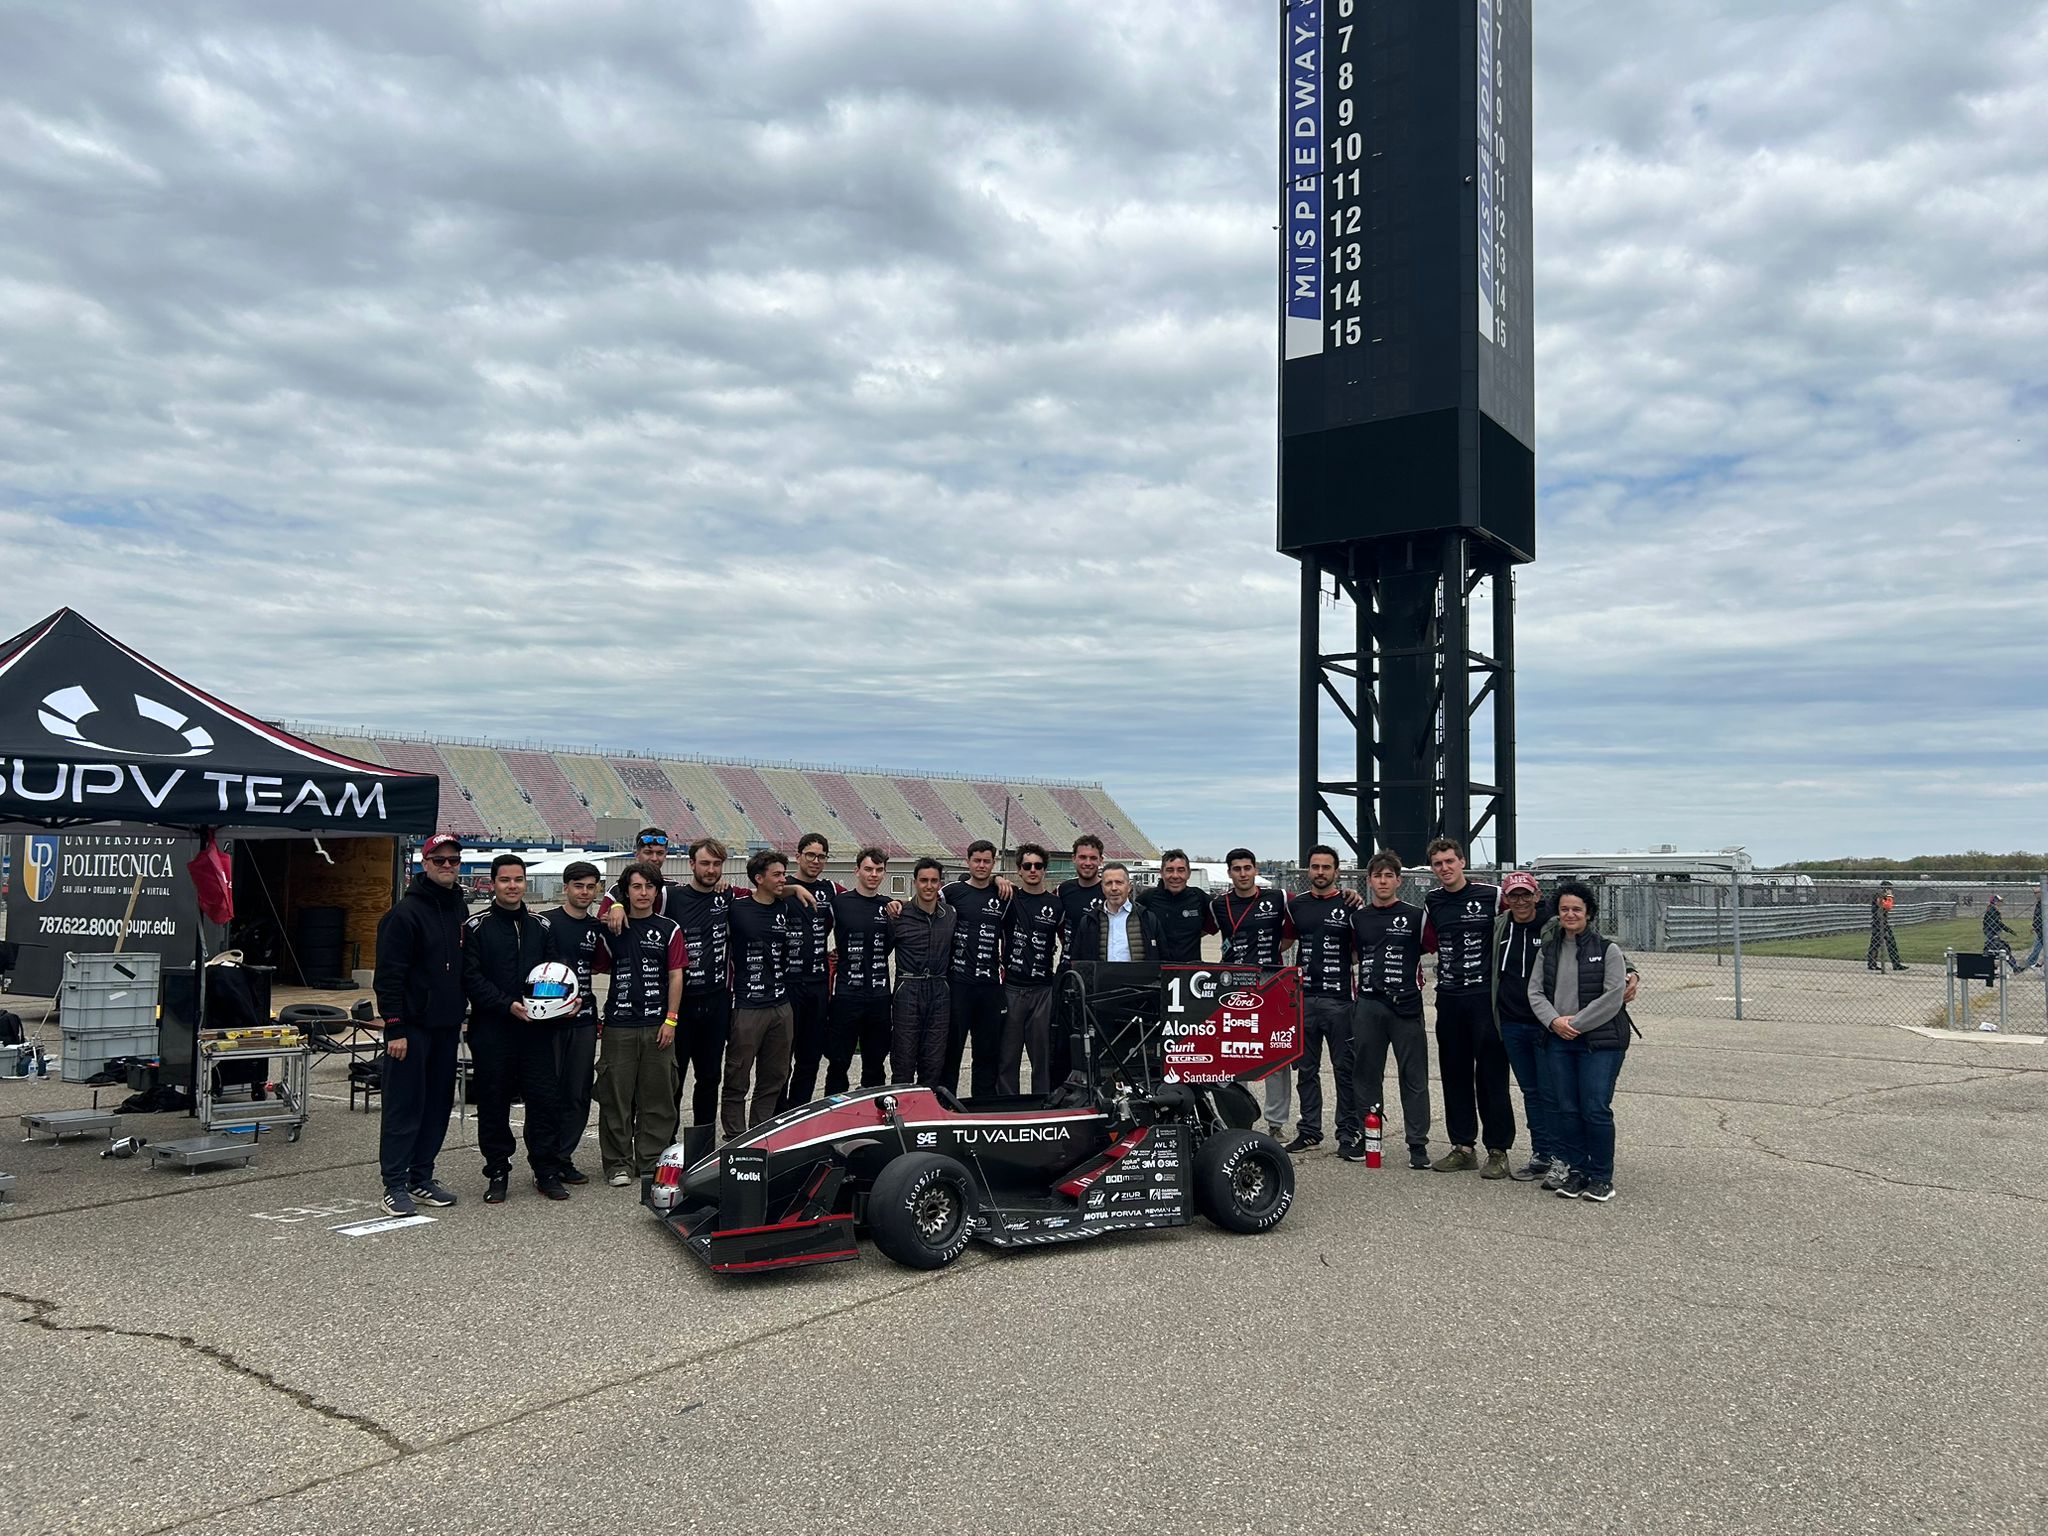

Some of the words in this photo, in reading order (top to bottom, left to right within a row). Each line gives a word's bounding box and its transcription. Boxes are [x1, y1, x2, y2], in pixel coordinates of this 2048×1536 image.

[1338, 0, 1354, 18] 6
[1338, 24, 1354, 54] 7
[1496, 21, 1502, 50] 7
[1338, 62, 1354, 91] 8
[1496, 60, 1502, 88] 8
[1338, 98, 1354, 127] 9
[1496, 96, 1502, 125] 9
[1295, 0, 1316, 300] MISPEEDWAY.
[1331, 132, 1362, 164] 10
[1494, 131, 1505, 164] 10
[1332, 168, 1360, 200] 11
[1494, 168, 1505, 201] 11
[1330, 205, 1361, 237] 12
[1494, 204, 1506, 239] 12
[1330, 242, 1361, 274] 13
[1494, 242, 1506, 275] 13
[1330, 279, 1361, 311] 14
[1494, 278, 1507, 311] 14
[1330, 316, 1361, 347] 15
[1495, 315, 1507, 348] 15
[0, 757, 185, 809] UPV
[203, 771, 388, 820] TEAM
[62, 853, 174, 878] POLITECNICA
[93, 886, 117, 895] ORLANDO
[147, 887, 170, 896] VIRTUAL
[39, 917, 122, 936] 787.622.8000
[125, 917, 176, 938] pupr.edu
[1167, 977, 1184, 1012] 1
[1228, 993, 1254, 1007] Ford
[1162, 1020, 1216, 1035] Alonso
[1223, 1016, 1258, 1029] HORSE
[1270, 1031, 1292, 1042] A123
[1164, 1039, 1195, 1053] Gurit
[1183, 1070, 1235, 1083] Santander
[917, 1132, 937, 1144] SAE
[953, 1130, 977, 1143] TU
[982, 1127, 1070, 1143] VALENCIA
[737, 1172, 761, 1181] Kolbi
[1142, 1161, 1155, 1169] 3M
[1165, 1160, 1179, 1168] SMC
[1121, 1191, 1140, 1199] ZIUR
[1084, 1210, 1109, 1220] MOTUL
[1111, 1209, 1142, 1217] FORVIA
